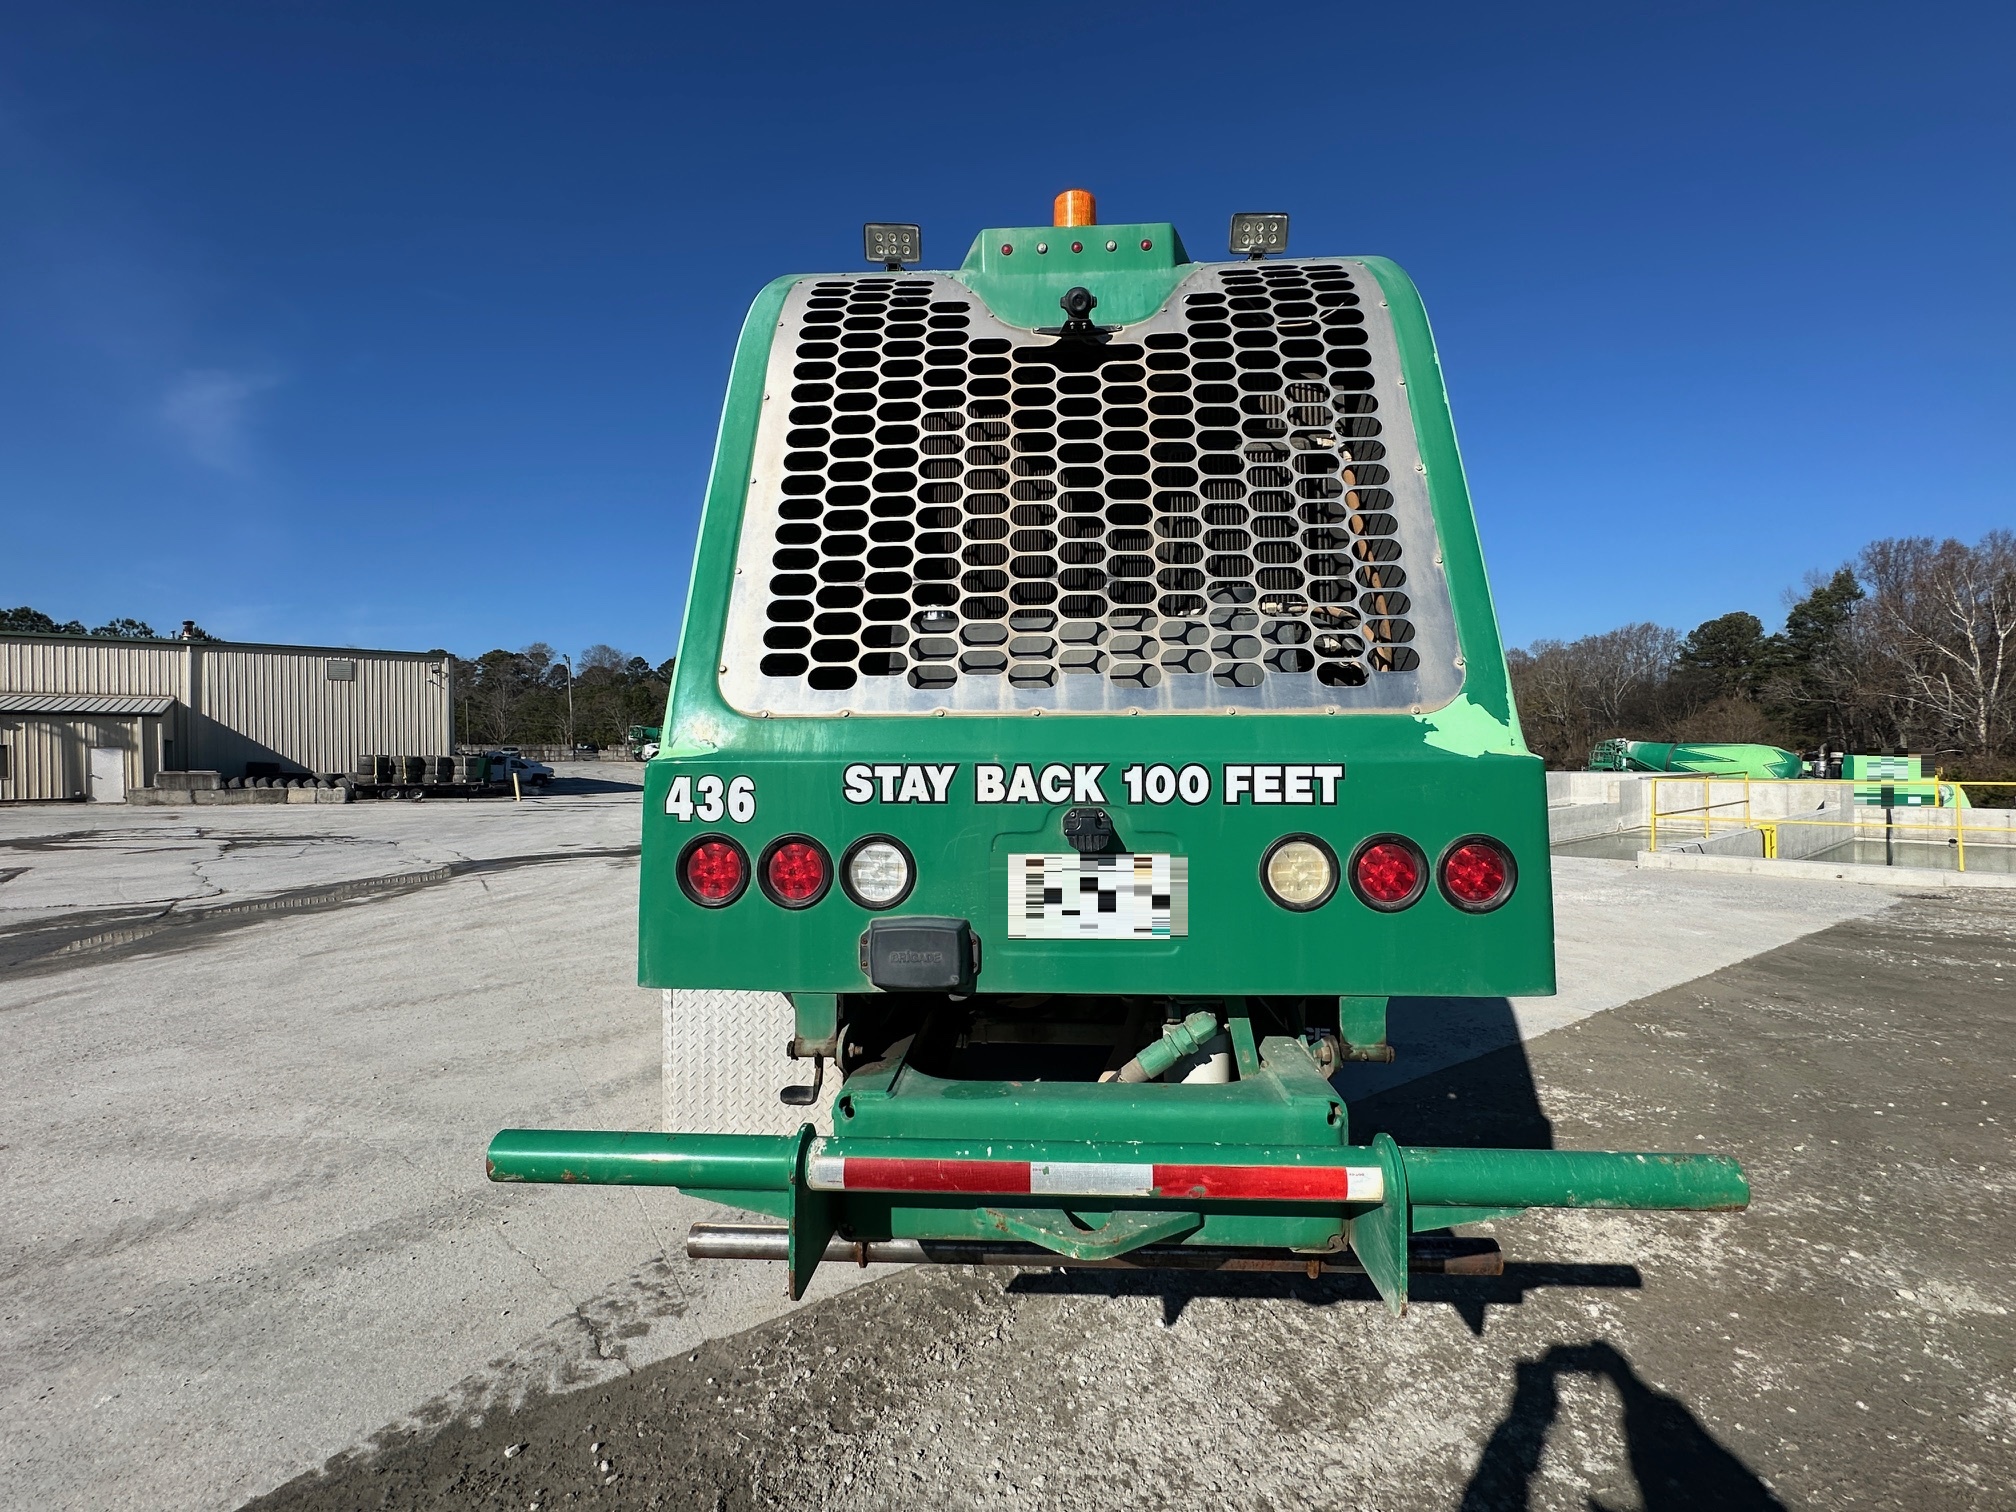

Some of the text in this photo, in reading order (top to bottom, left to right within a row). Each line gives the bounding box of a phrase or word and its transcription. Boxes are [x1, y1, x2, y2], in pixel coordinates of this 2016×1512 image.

[665, 775, 756, 823] 436
[843, 763, 1345, 805] STAY BACK 100 FEET
